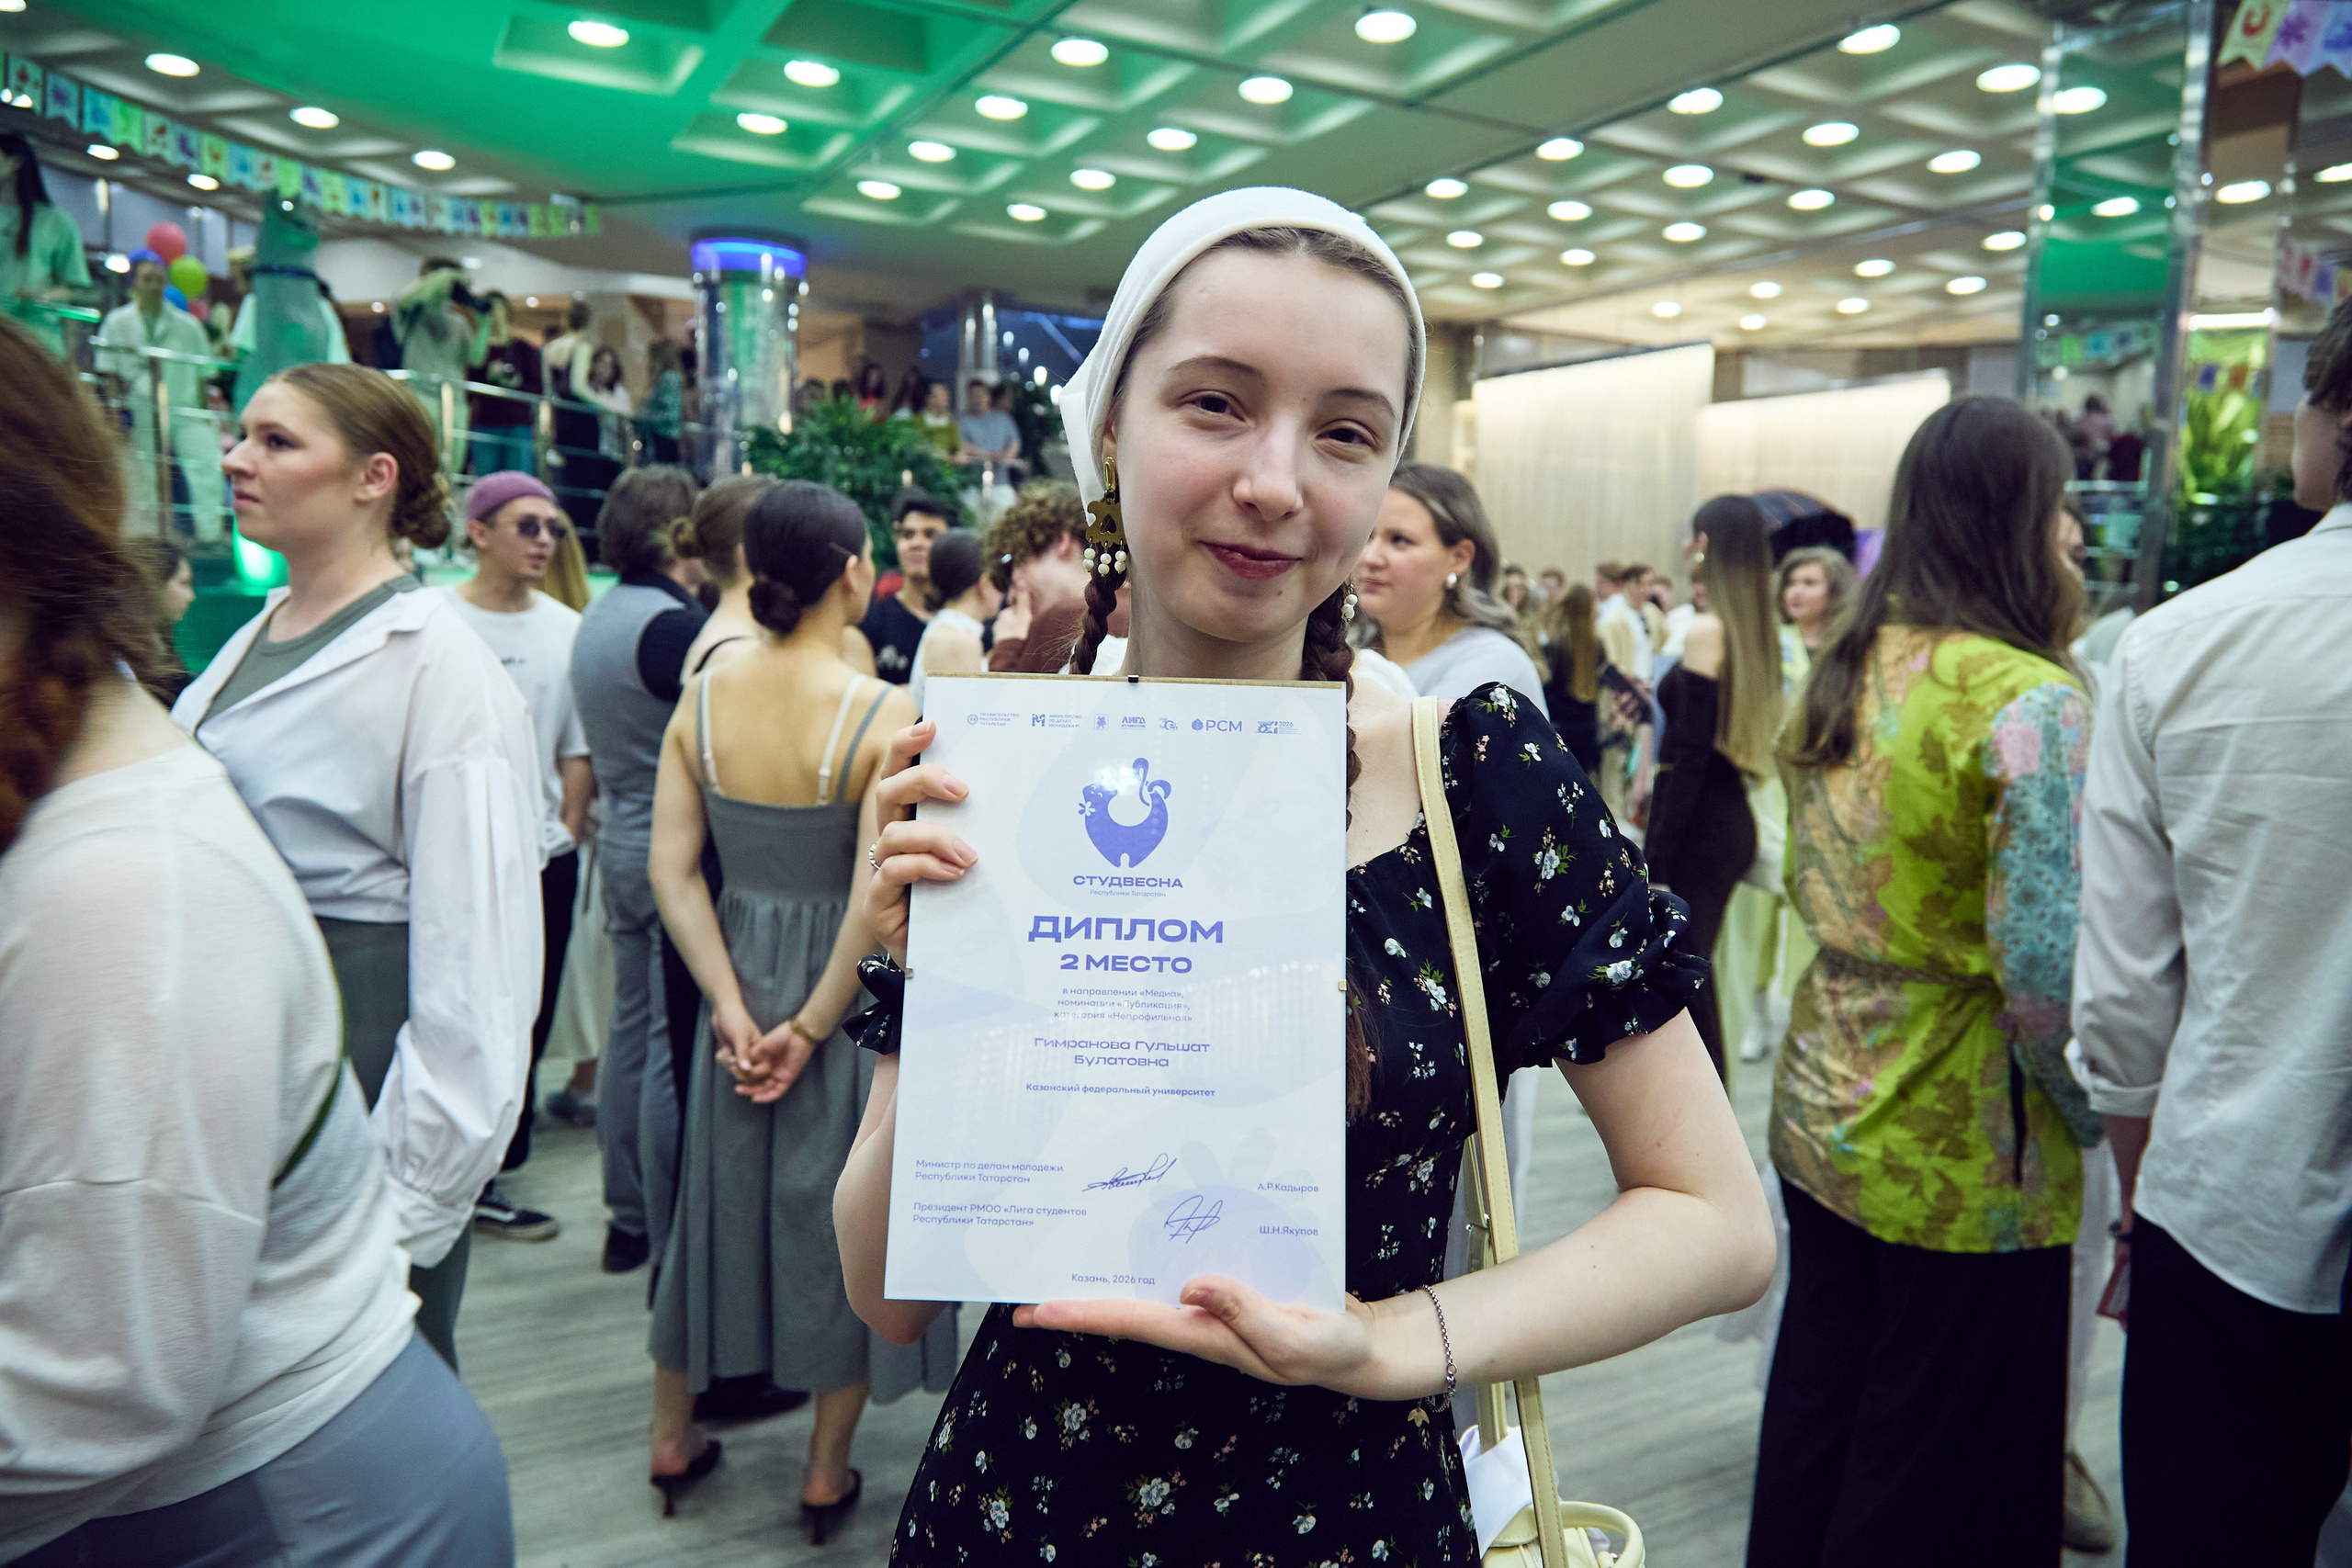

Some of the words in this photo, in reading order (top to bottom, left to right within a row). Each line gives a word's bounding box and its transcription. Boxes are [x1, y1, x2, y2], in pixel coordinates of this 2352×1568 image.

[1206, 720, 1243, 732] РСМ
[1073, 875, 1183, 888] СТУДВЕСНА
[1028, 915, 1223, 943] ДИПЛОМ
[1060, 954, 1079, 970] 2
[1086, 954, 1192, 974] МЕСТО
[1070, 988, 1137, 997] направлении
[1139, 989, 1184, 998] «Медиа»,
[1057, 999, 1114, 1008] номинации
[1107, 1012, 1193, 1022] «Непрофильная»
[1034, 1038, 1131, 1049] Гимранова
[1135, 1041, 1210, 1053] Гульшат
[1074, 1055, 1169, 1067] Булатовна
[1026, 1083, 1080, 1092] Казанский
[1082, 1084, 1150, 1095] федеральный
[1152, 1088, 1216, 1097] университет
[916, 1160, 961, 1170] Министр
[978, 1162, 1009, 1171] делам
[1012, 1164, 1063, 1173] молодежи
[915, 1172, 975, 1182] Республики
[978, 1173, 1030, 1184] Татарстан
[1257, 1183, 1319, 1194] А.Р.Кадыров
[914, 1202, 968, 1213] Президент
[970, 1204, 1001, 1213] РМОО
[1004, 1205, 1034, 1214] «Лига
[1036, 1207, 1087, 1217] студентов
[913, 1214, 973, 1225] Республики
[976, 1217, 1034, 1228] Татарстан»
[1259, 1226, 1319, 1237] Ш.Н.Якупов
[1072, 1274, 1110, 1284] Казань,
[1113, 1275, 1136, 1284] 2026
[1138, 1277, 1155, 1285] год
